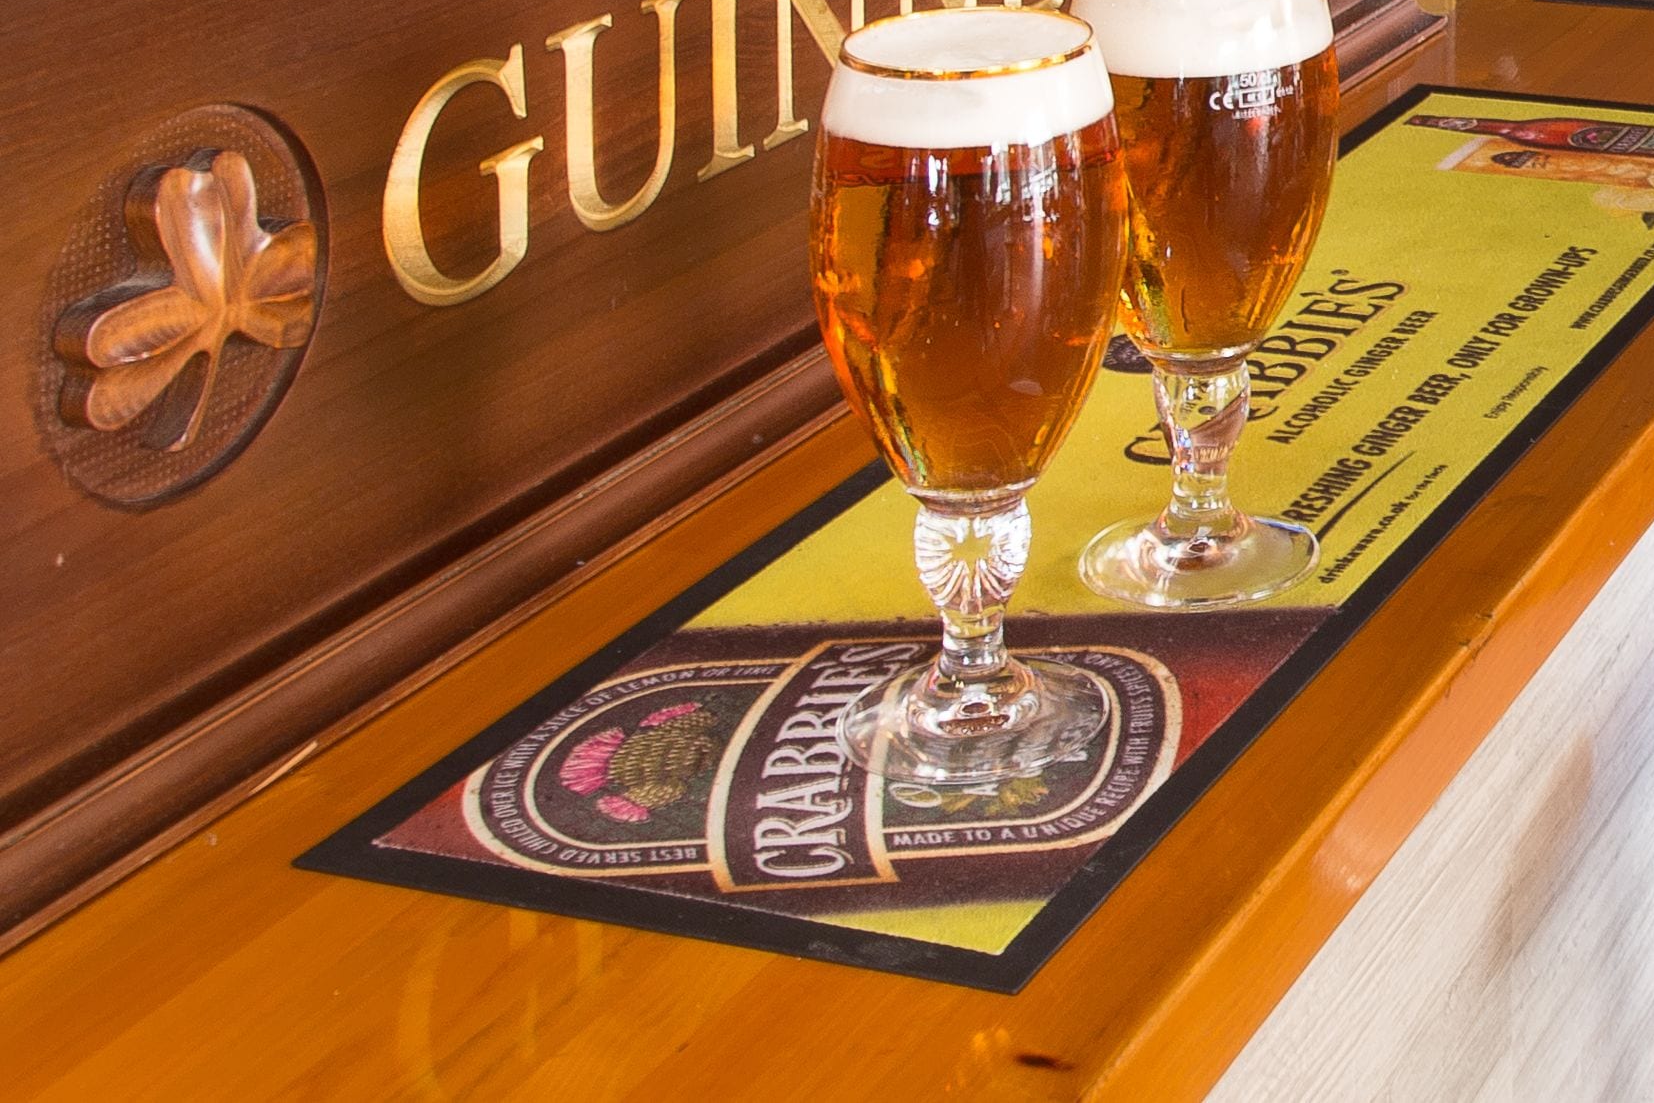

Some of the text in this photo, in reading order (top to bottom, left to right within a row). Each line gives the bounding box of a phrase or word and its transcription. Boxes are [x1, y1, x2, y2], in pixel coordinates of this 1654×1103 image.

[1266, 310, 1439, 444] ALCOHOLIC GINGER BEER
[1281, 246, 1599, 523] RESHING GINGER BEER, ONLY FOR GROWN-UPS
[1318, 501, 1410, 584] drinkaware.co.uk
[616, 669, 696, 694] LEMON
[1111, 664, 1152, 697] SPICES
[583, 691, 616, 706] OF
[543, 706, 590, 733] SLICE
[1130, 697, 1155, 736] FRUITS
[535, 732, 551, 744] A
[1122, 735, 1152, 769] WITH
[503, 741, 540, 775] WITH
[754, 643, 924, 877] CRABBIE'S
[495, 771, 523, 791] ICE
[1096, 767, 1142, 807] RECIPE
[491, 787, 518, 819] OVER
[1001, 829, 1016, 841] A
[1023, 801, 1109, 838] UNIQUE
[500, 817, 560, 855] CHILLED
[892, 830, 956, 847] MADE
[965, 829, 992, 843] TO
[559, 848, 642, 864] SERVED
[649, 847, 698, 860] BEST
